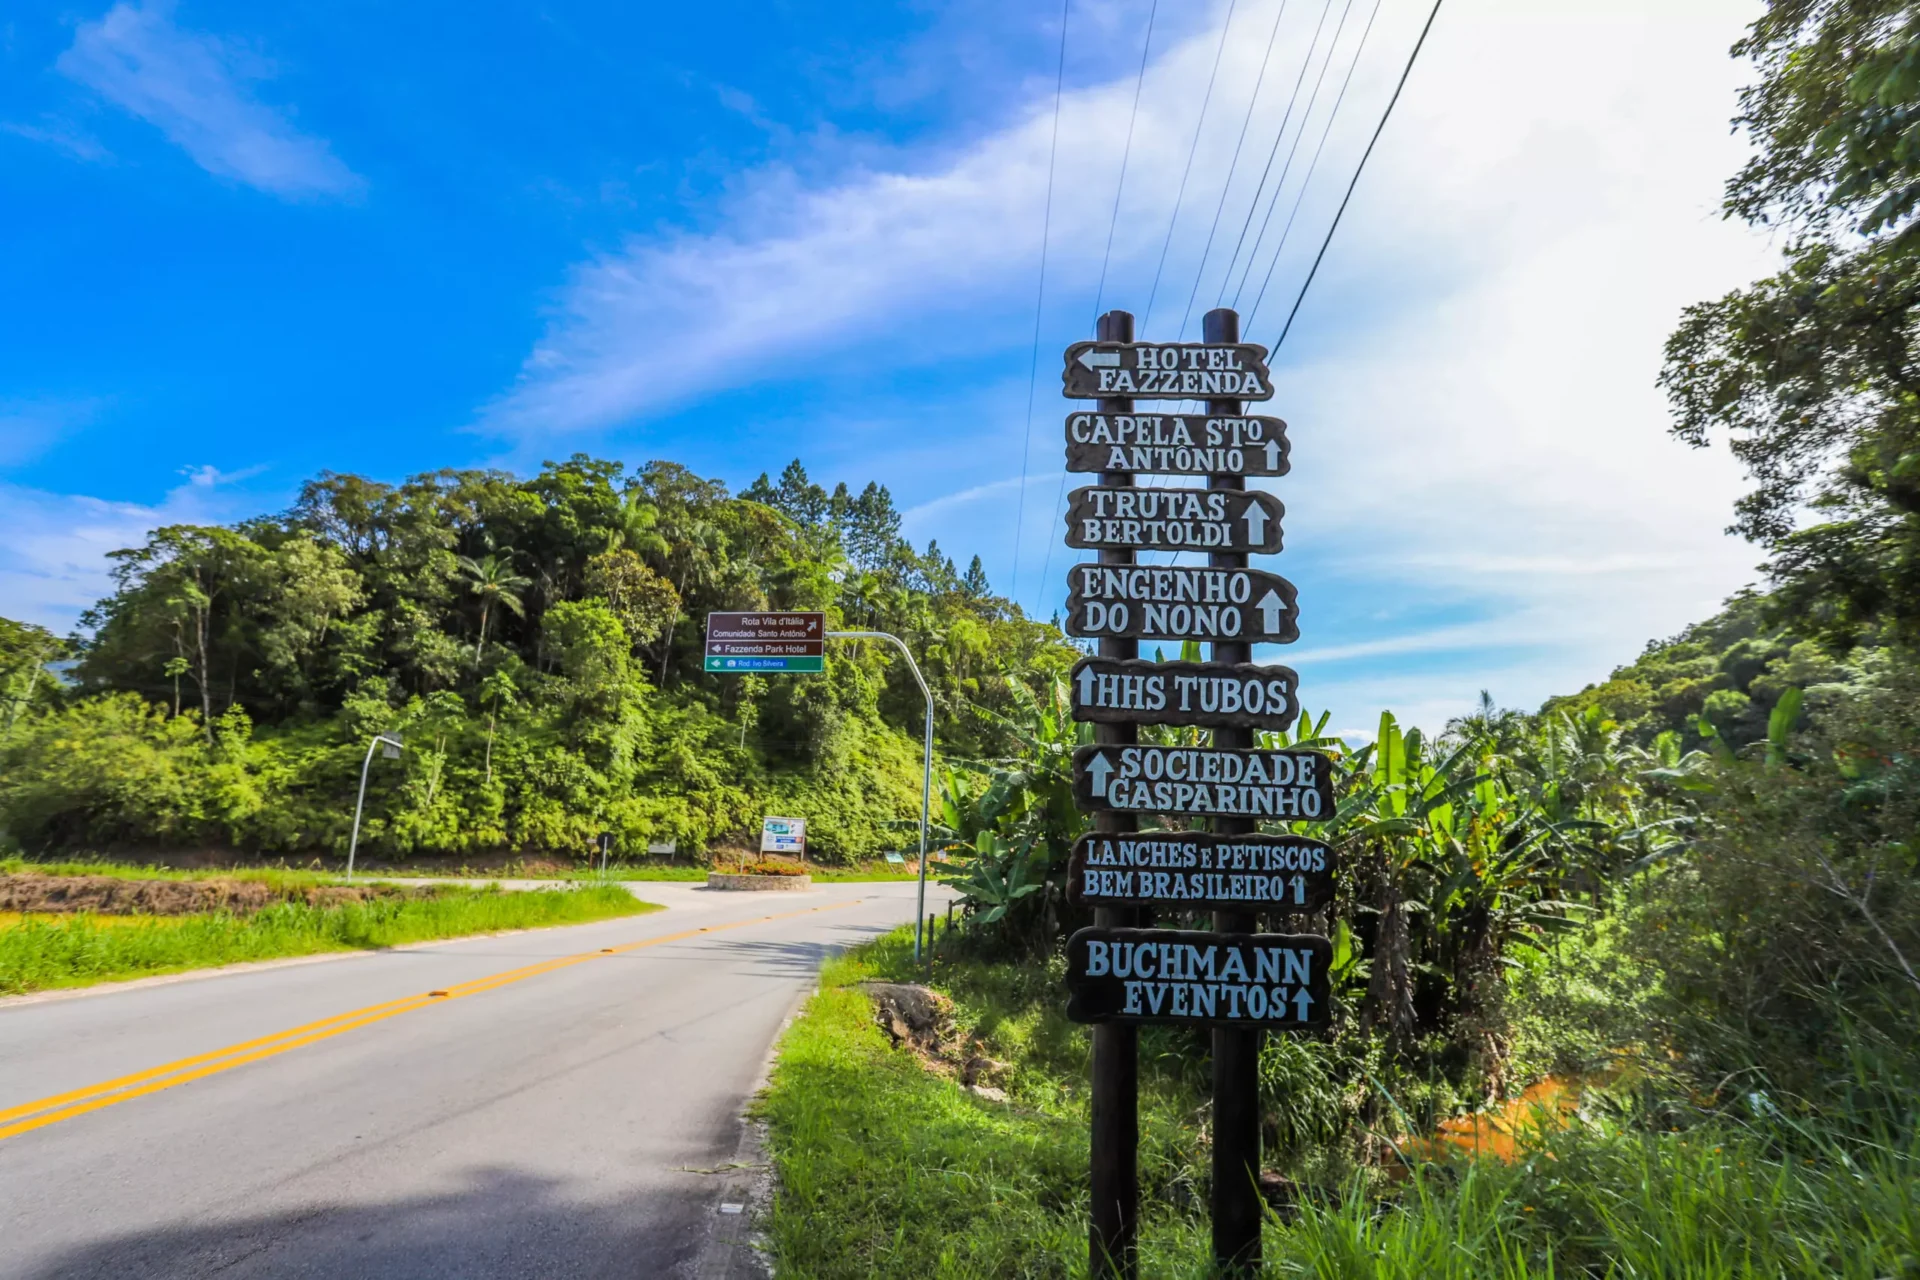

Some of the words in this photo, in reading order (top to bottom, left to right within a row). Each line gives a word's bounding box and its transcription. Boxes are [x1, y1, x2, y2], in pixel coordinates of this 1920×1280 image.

[1136, 348, 1243, 370] HOTEL
[1098, 369, 1265, 394] FAZZENDA
[1072, 415, 1195, 446] CAPELA
[1106, 445, 1244, 472] ANTÔNIO
[1087, 490, 1226, 521] TRUTAS
[1082, 519, 1232, 546] BERTOLDI
[1081, 567, 1251, 603] ENGENHO
[780, 629, 806, 637] Antônio
[1083, 602, 1129, 633] DO
[1142, 603, 1242, 637] NONO
[725, 645, 762, 653] Fazzenda
[765, 645, 783, 653] Park
[786, 645, 806, 653] Hotel
[1096, 674, 1166, 711] HHS
[1175, 676, 1288, 715] TUBOS
[1120, 748, 1316, 787] SOCIEDADE
[1108, 779, 1321, 817] GASPARINHO
[1086, 840, 1197, 867] LANCHES
[1200, 847, 1212, 869] E
[1216, 844, 1325, 872] PETISCOS
[1082, 870, 1133, 897] BEM
[1138, 872, 1284, 901] BRASILEIRO
[1085, 940, 1313, 985] BUCHMANN
[1123, 981, 1288, 1019] EVENTOS
